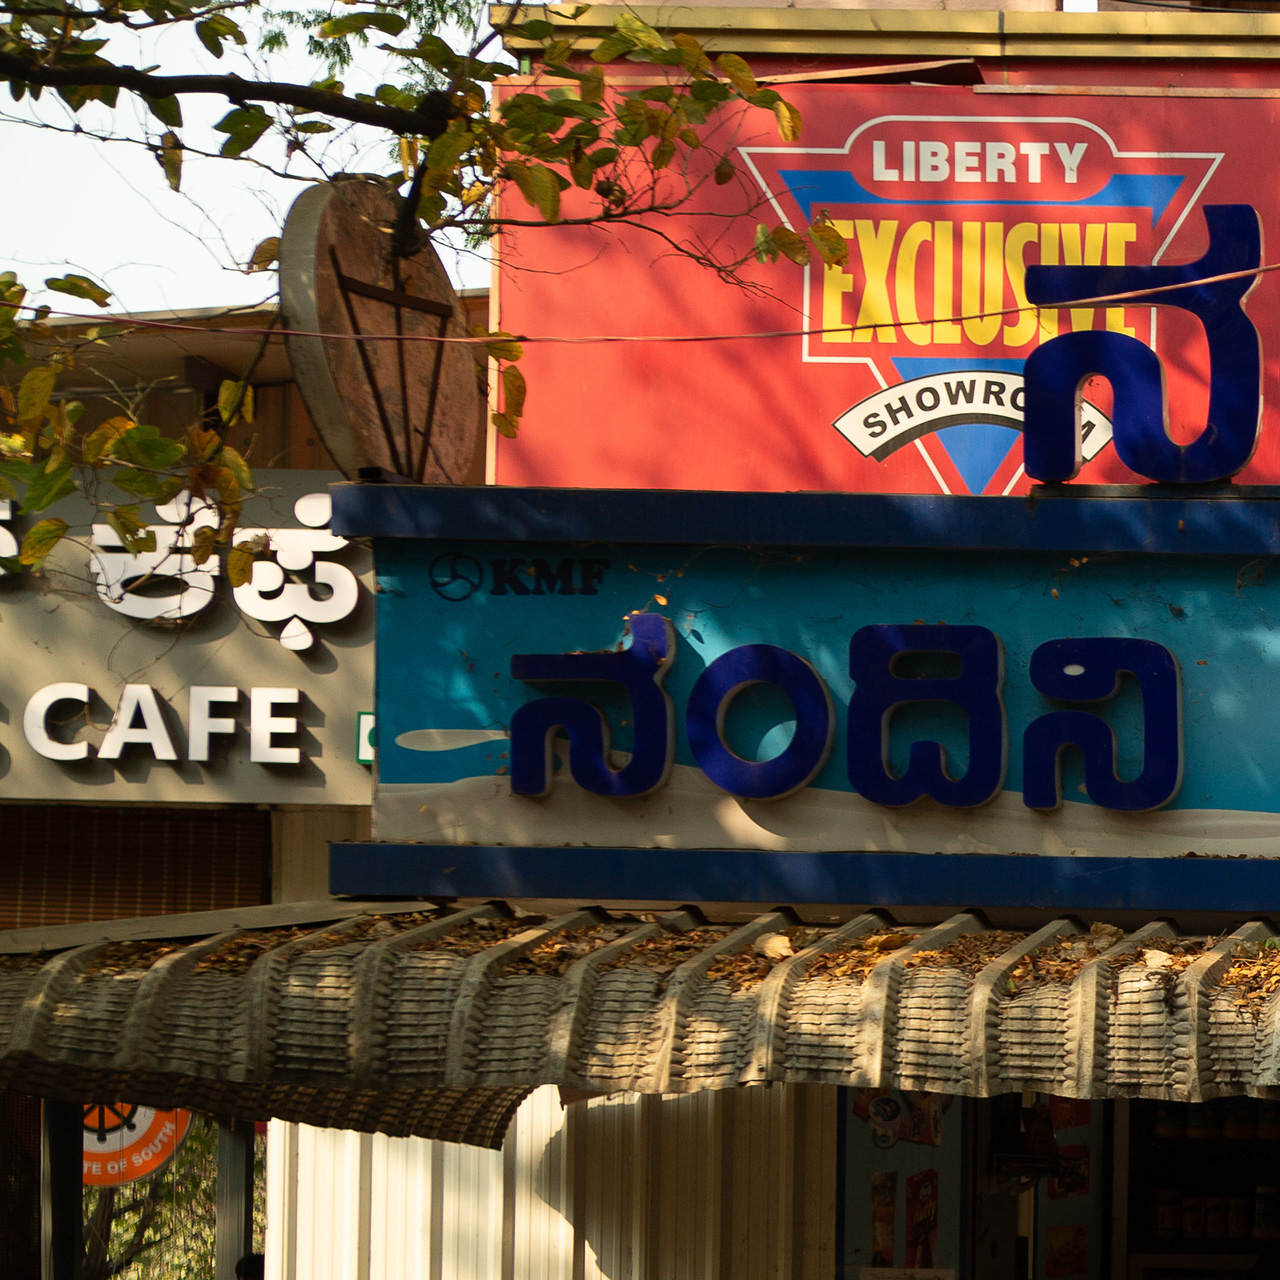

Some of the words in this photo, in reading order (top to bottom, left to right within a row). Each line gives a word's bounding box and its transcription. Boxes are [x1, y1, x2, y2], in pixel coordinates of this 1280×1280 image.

[872, 140, 1089, 184] LIBERTY
[821, 218, 1137, 347] EXCLUSIVE
[861, 378, 1097, 446] SHOWRO
[485, 556, 611, 597] KMF
[22, 682, 302, 765] CAFE
[510, 612, 1185, 812] ನಂದಿನಿ
[106, 1158, 128, 1175] OF
[131, 1121, 177, 1168] SOUTH
